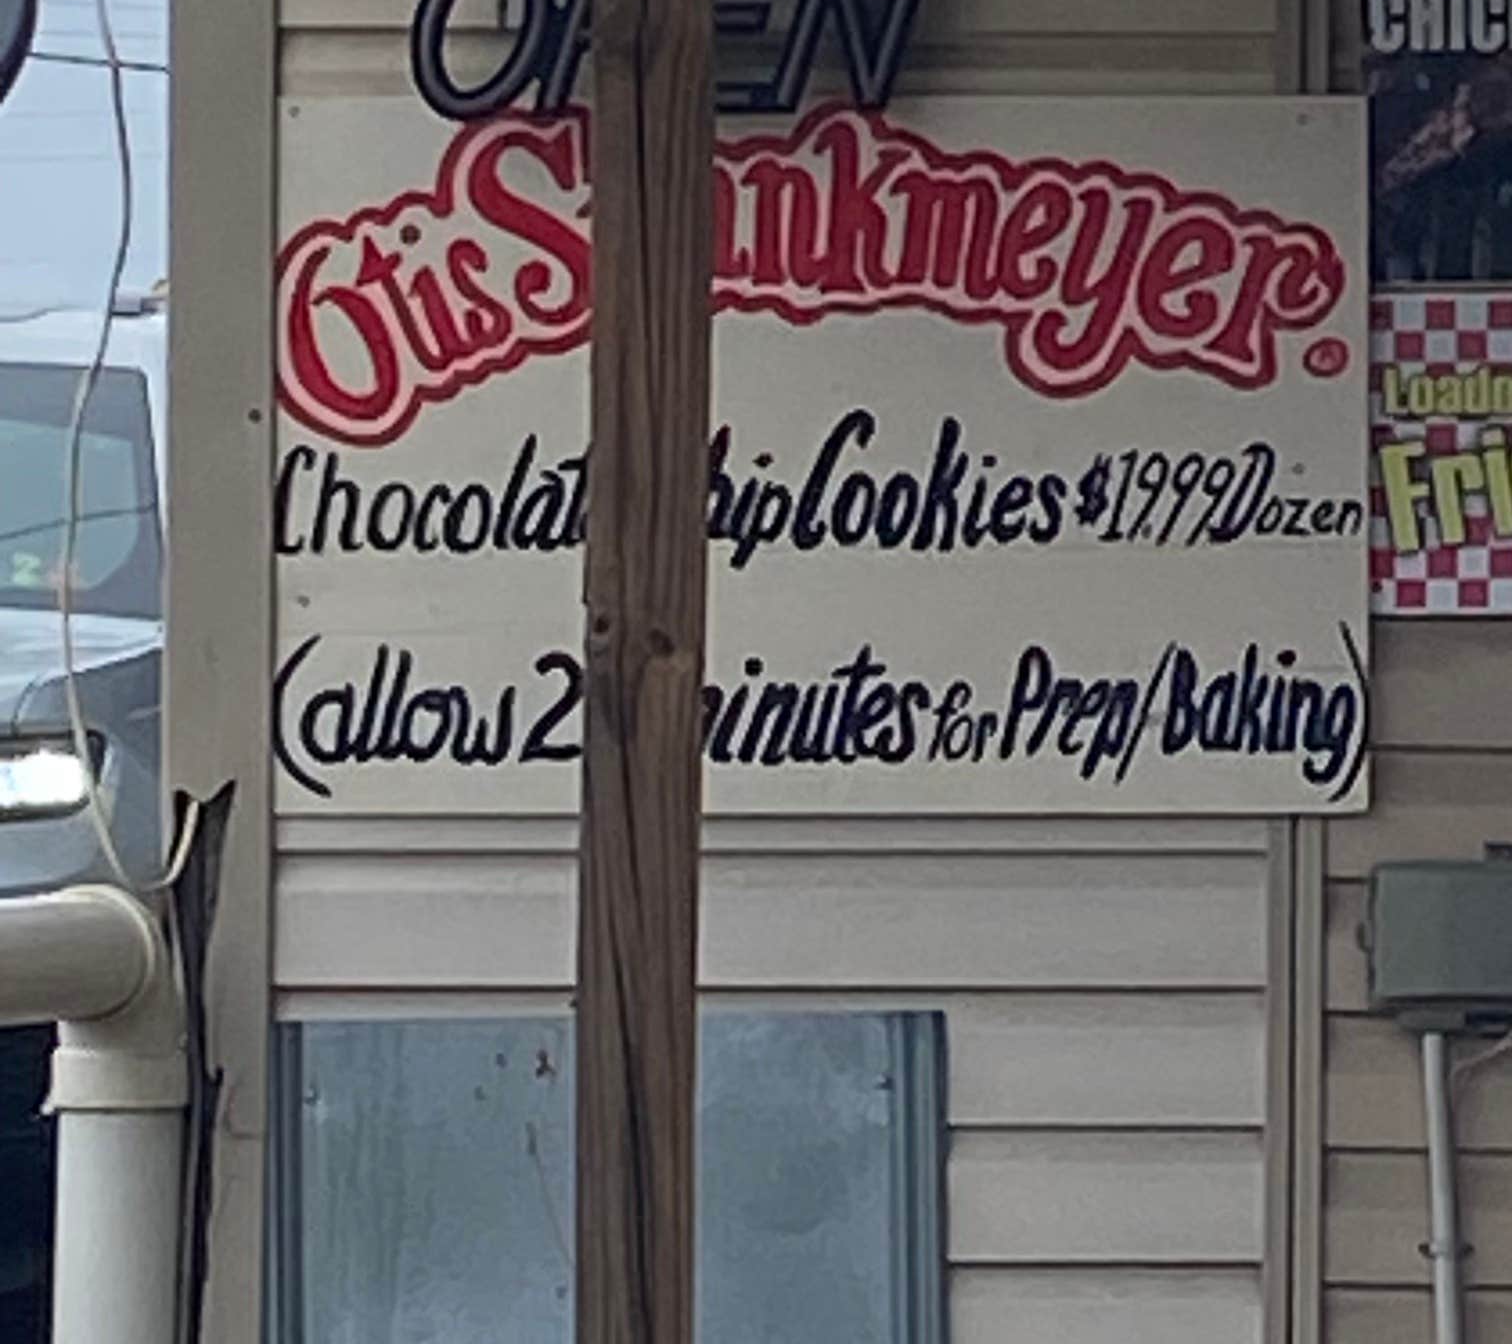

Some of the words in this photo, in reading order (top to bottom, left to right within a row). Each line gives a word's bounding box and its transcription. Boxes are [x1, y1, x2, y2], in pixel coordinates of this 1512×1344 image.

[288, 223, 513, 422] Otis
[466, 113, 1334, 378] Snkmeyer
[273, 434, 588, 555] Chocolat
[705, 424, 793, 569] hip
[791, 408, 1067, 551] Cookies
[1205, 442, 1363, 546] Dozen
[271, 634, 517, 799] (allow
[700, 644, 931, 766] inutes
[929, 679, 1000, 764] for
